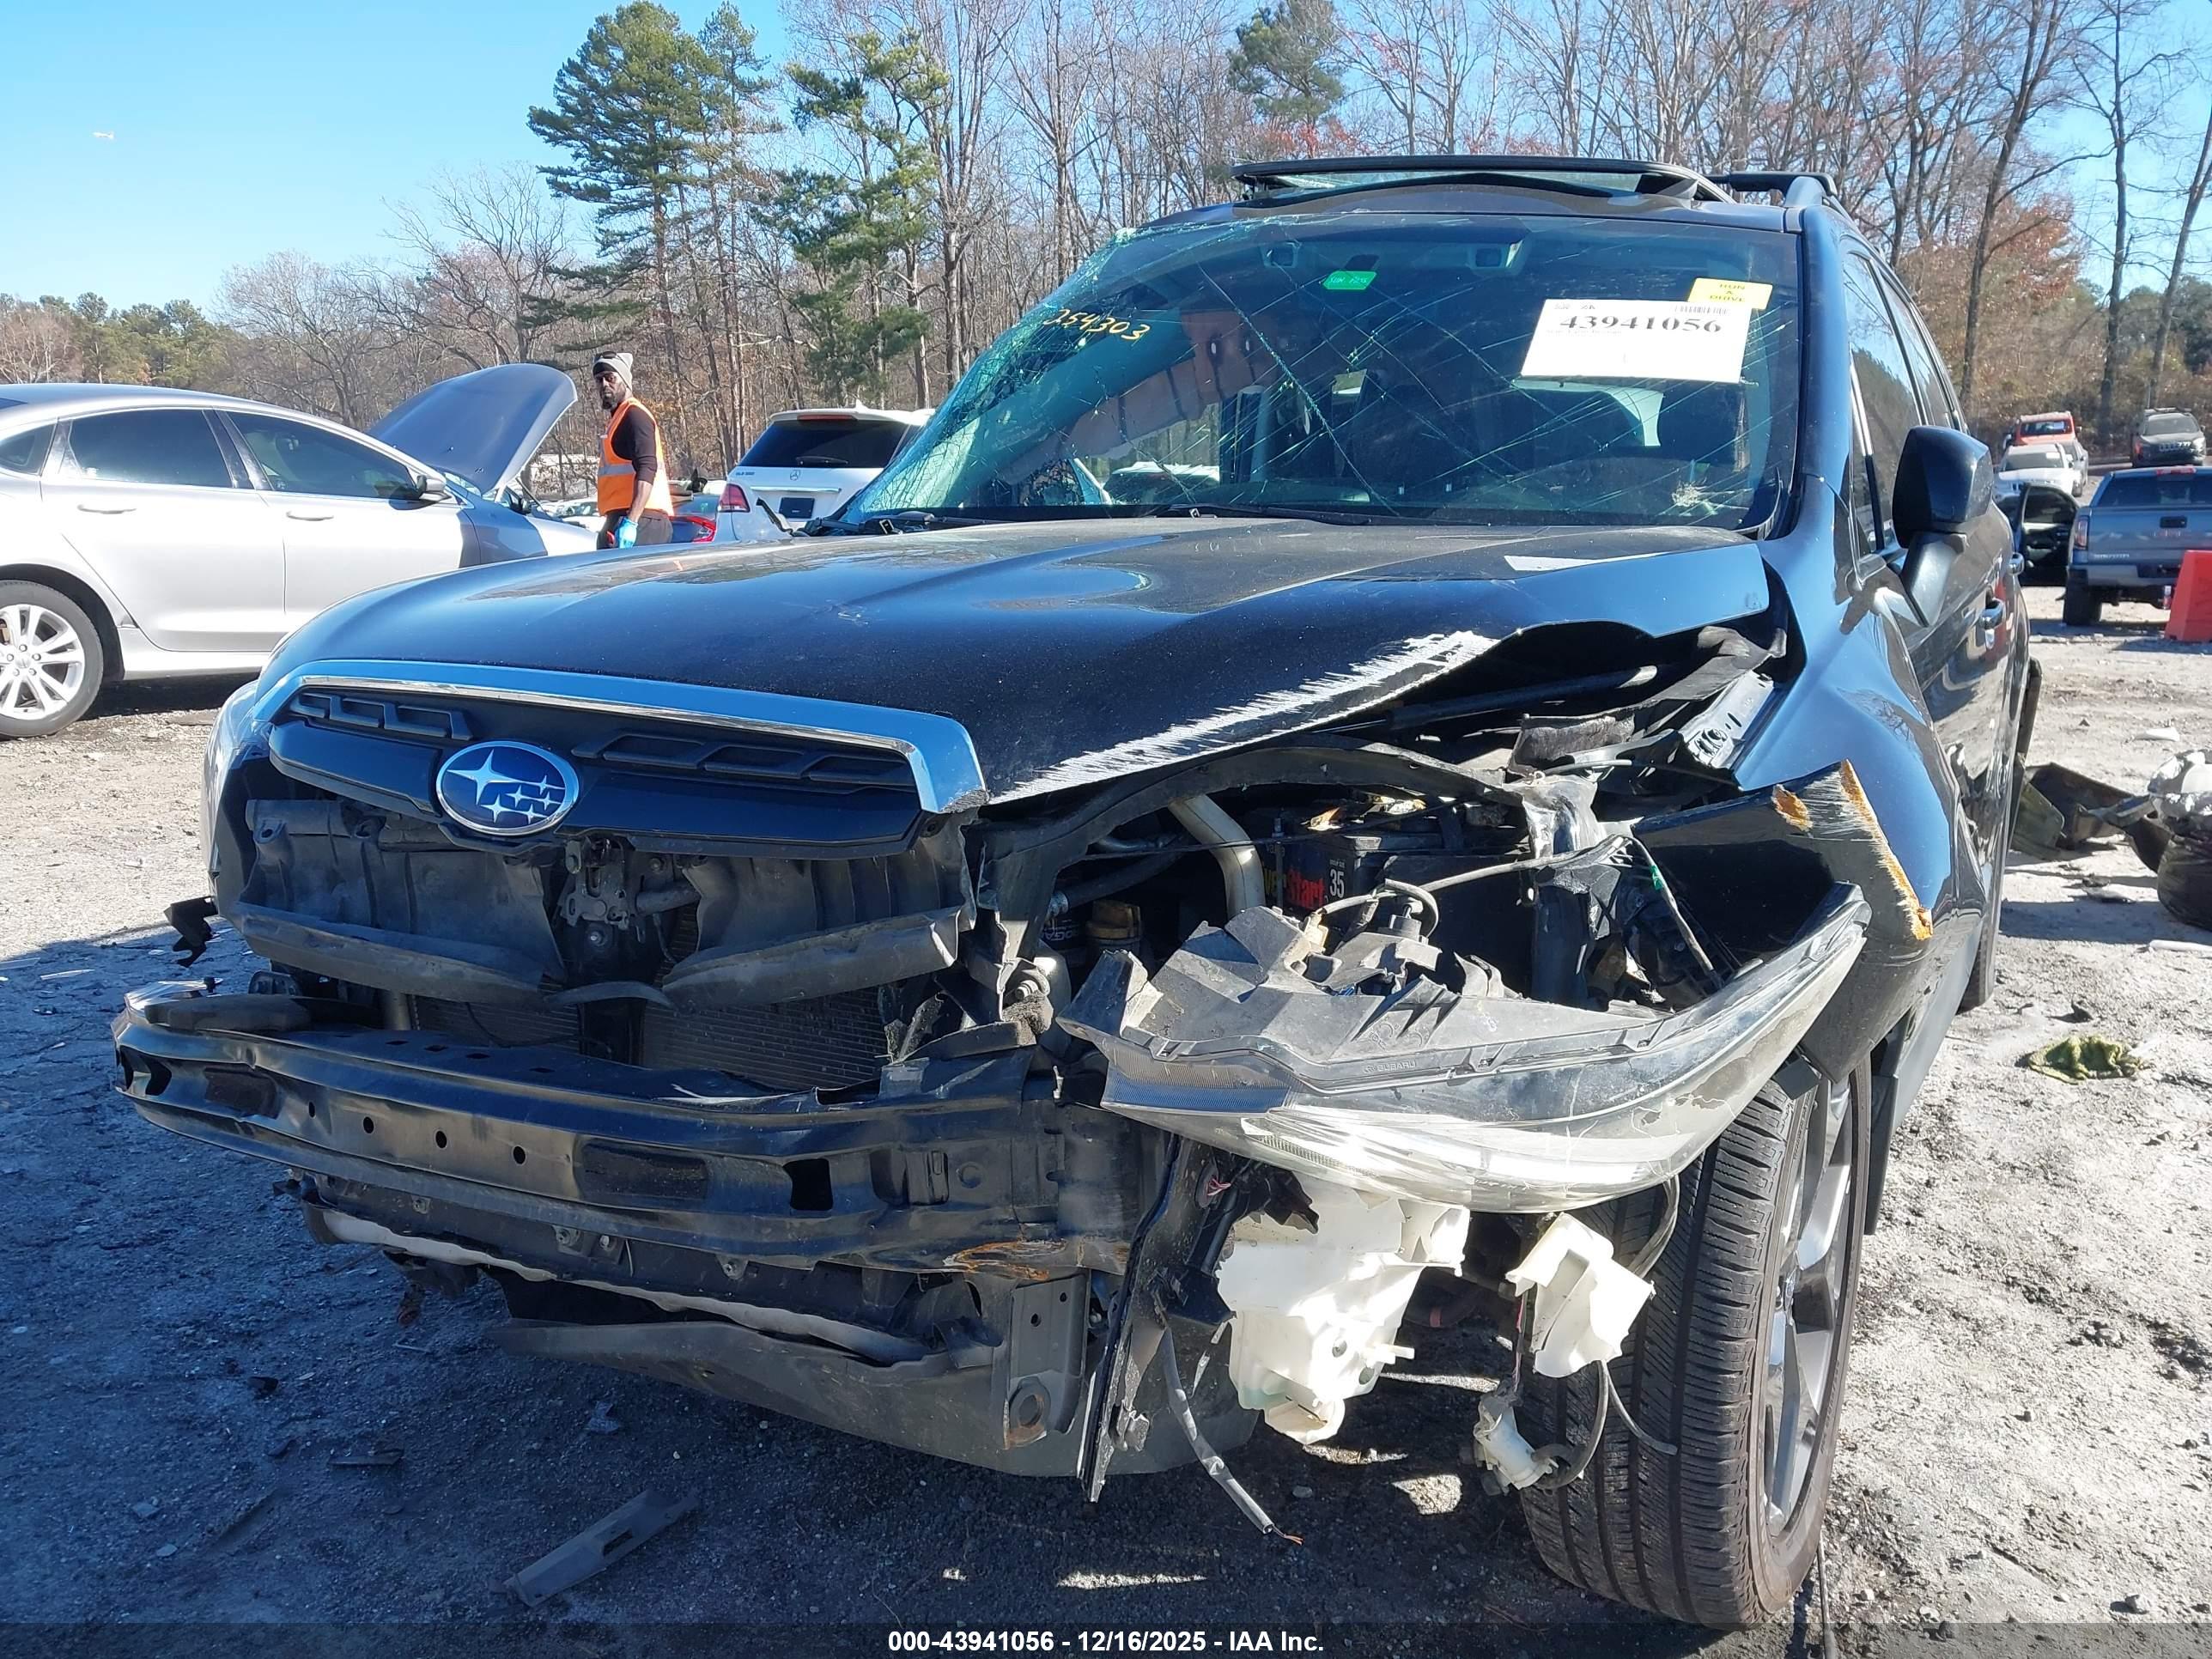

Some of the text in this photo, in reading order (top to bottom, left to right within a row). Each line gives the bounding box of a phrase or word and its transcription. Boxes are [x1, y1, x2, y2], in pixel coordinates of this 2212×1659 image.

[1042, 309, 1151, 340] 254303
[1560, 315, 1723, 333] 43941056
[1329, 868, 1345, 898] 35
[1377, 1058, 1417, 1073] SUBARU
